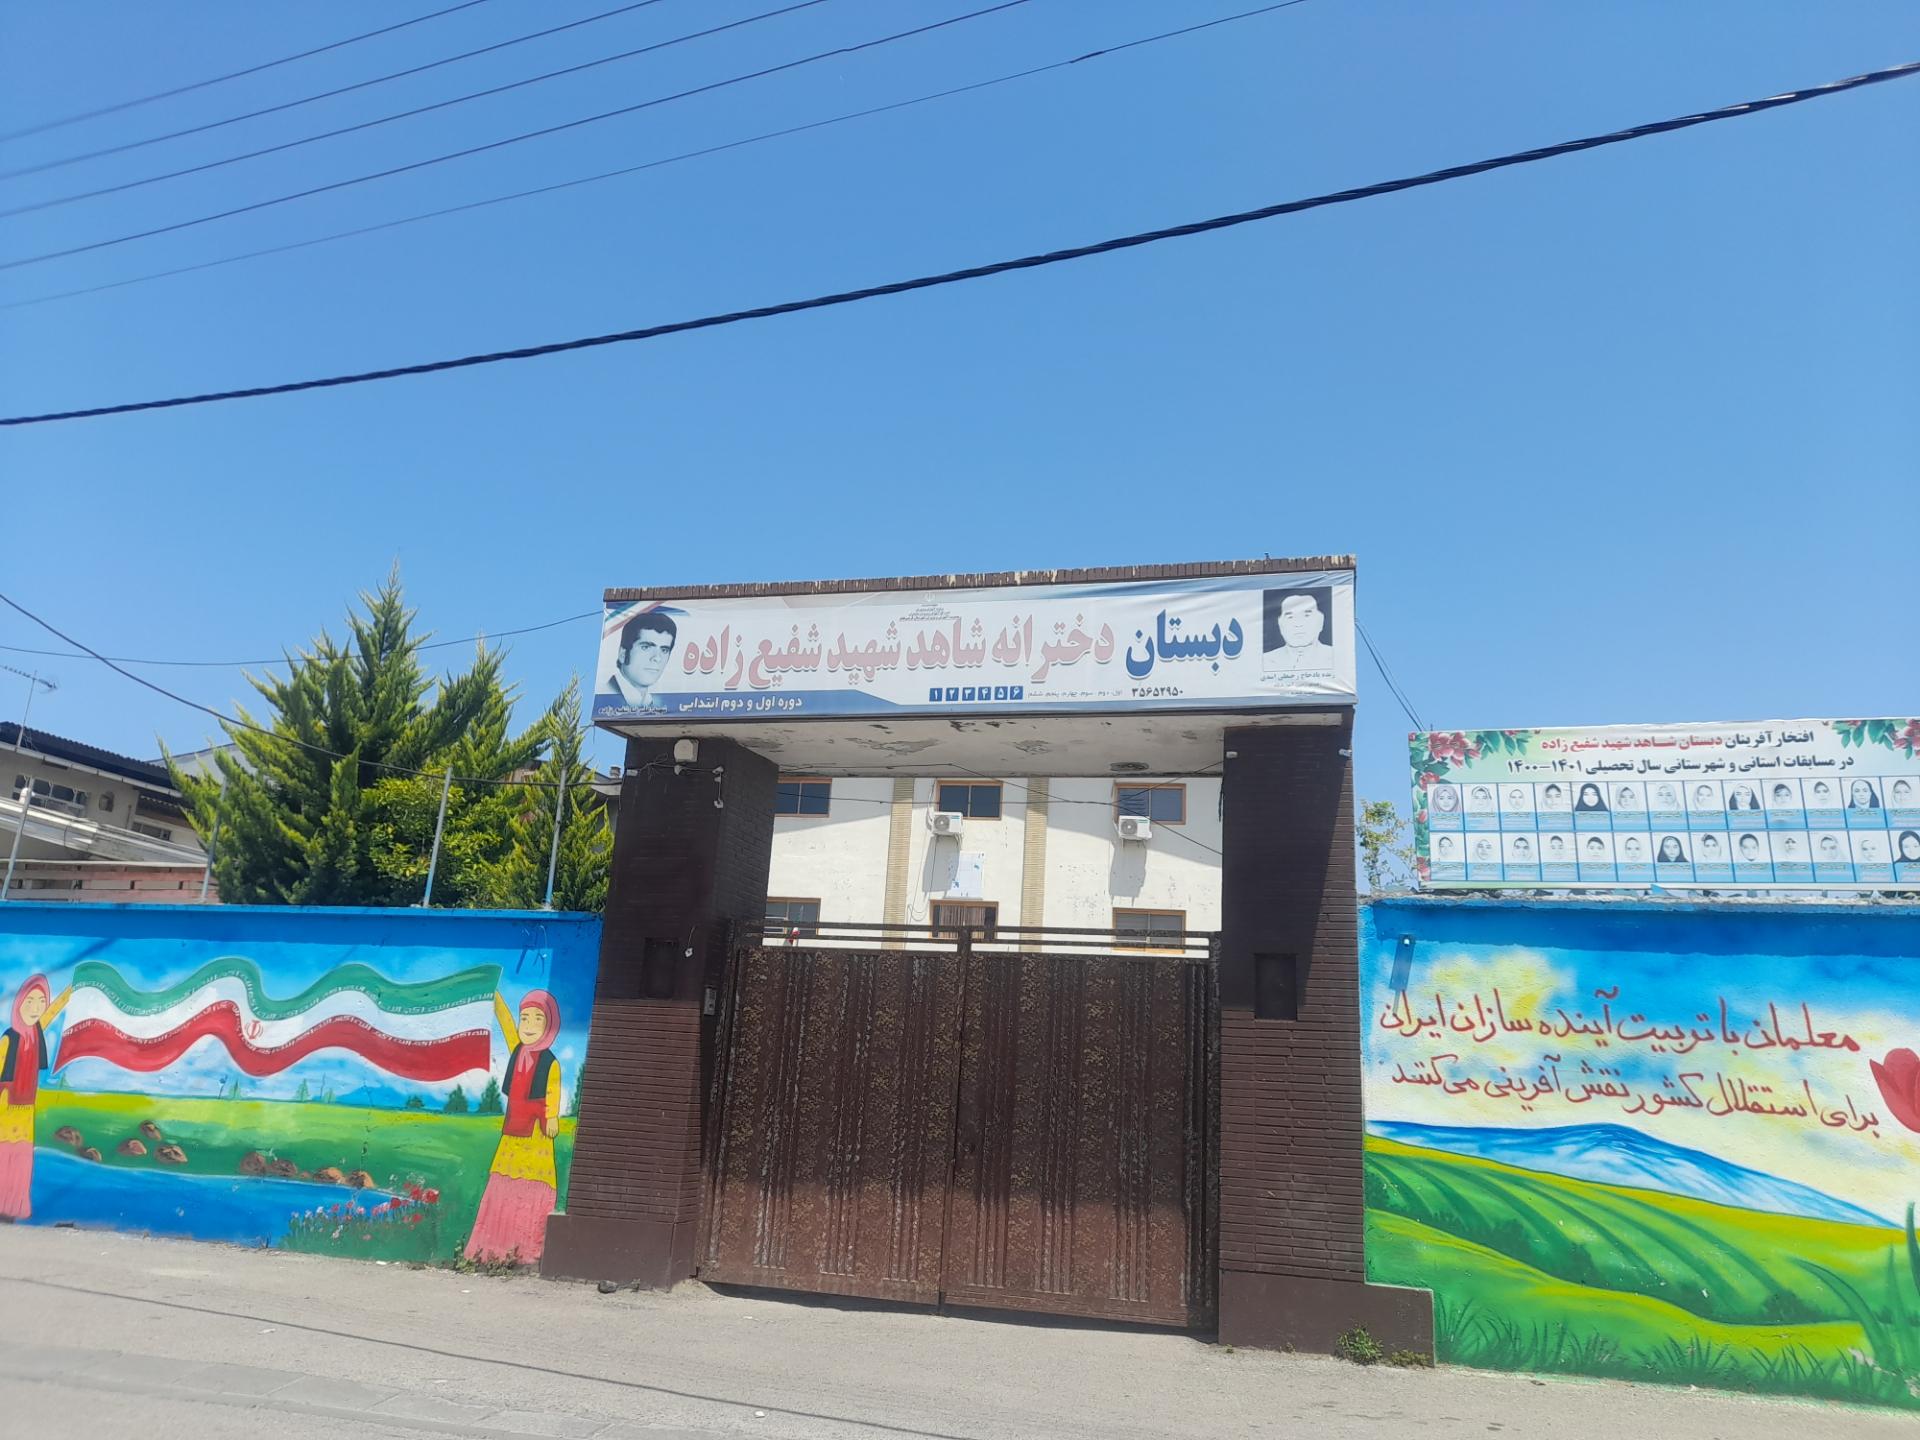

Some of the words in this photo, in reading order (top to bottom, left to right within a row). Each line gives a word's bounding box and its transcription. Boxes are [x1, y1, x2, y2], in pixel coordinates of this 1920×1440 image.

[827, 620, 900, 685] شهید
[906, 617, 986, 676] شاهد
[992, 612, 1115, 684] دخترانه
[1125, 609, 1244, 680] دبستان
[682, 624, 744, 690] زاده
[749, 624, 822, 690] شفیع
[679, 696, 719, 713] ابتدایی
[721, 698, 744, 712] دوم
[747, 700, 753, 711] و
[755, 695, 775, 711] اول
[777, 696, 803, 711] دوره
[1541, 738, 1568, 753] زاده
[1570, 738, 1600, 752] شفیع
[1602, 737, 1633, 751] شهید
[1679, 735, 1723, 751] دبستان
[1724, 731, 1772, 749] آفرینان
[1777, 731, 1815, 748] افتخار
[1585, 759, 1634, 775] تحصیلی
[1637, 759, 1661, 774] سال
[1664, 757, 1726, 774] شهرستانی
[1729, 761, 1736, 772] و
[1738, 756, 1781, 772] استانی
[1783, 755, 1836, 770] مسابقات
[1839, 756, 1854, 770] در
[1379, 989, 1446, 1039] ایران
[1449, 987, 1533, 1043] سازان
[1617, 1013, 1715, 1054] تربیت
[1718, 996, 1741, 1056] با
[1744, 1001, 1861, 1052] معلمان
[1392, 1053, 1459, 1086] کنند
[1443, 1074, 1481, 1094] می
[1483, 1053, 1562, 1112] آفرینی
[1565, 1059, 1631, 1103] نقش
[1621, 1073, 1704, 1115] کشور
[1706, 1072, 1817, 1119] استقلال
[1819, 1094, 1880, 1139] برای
